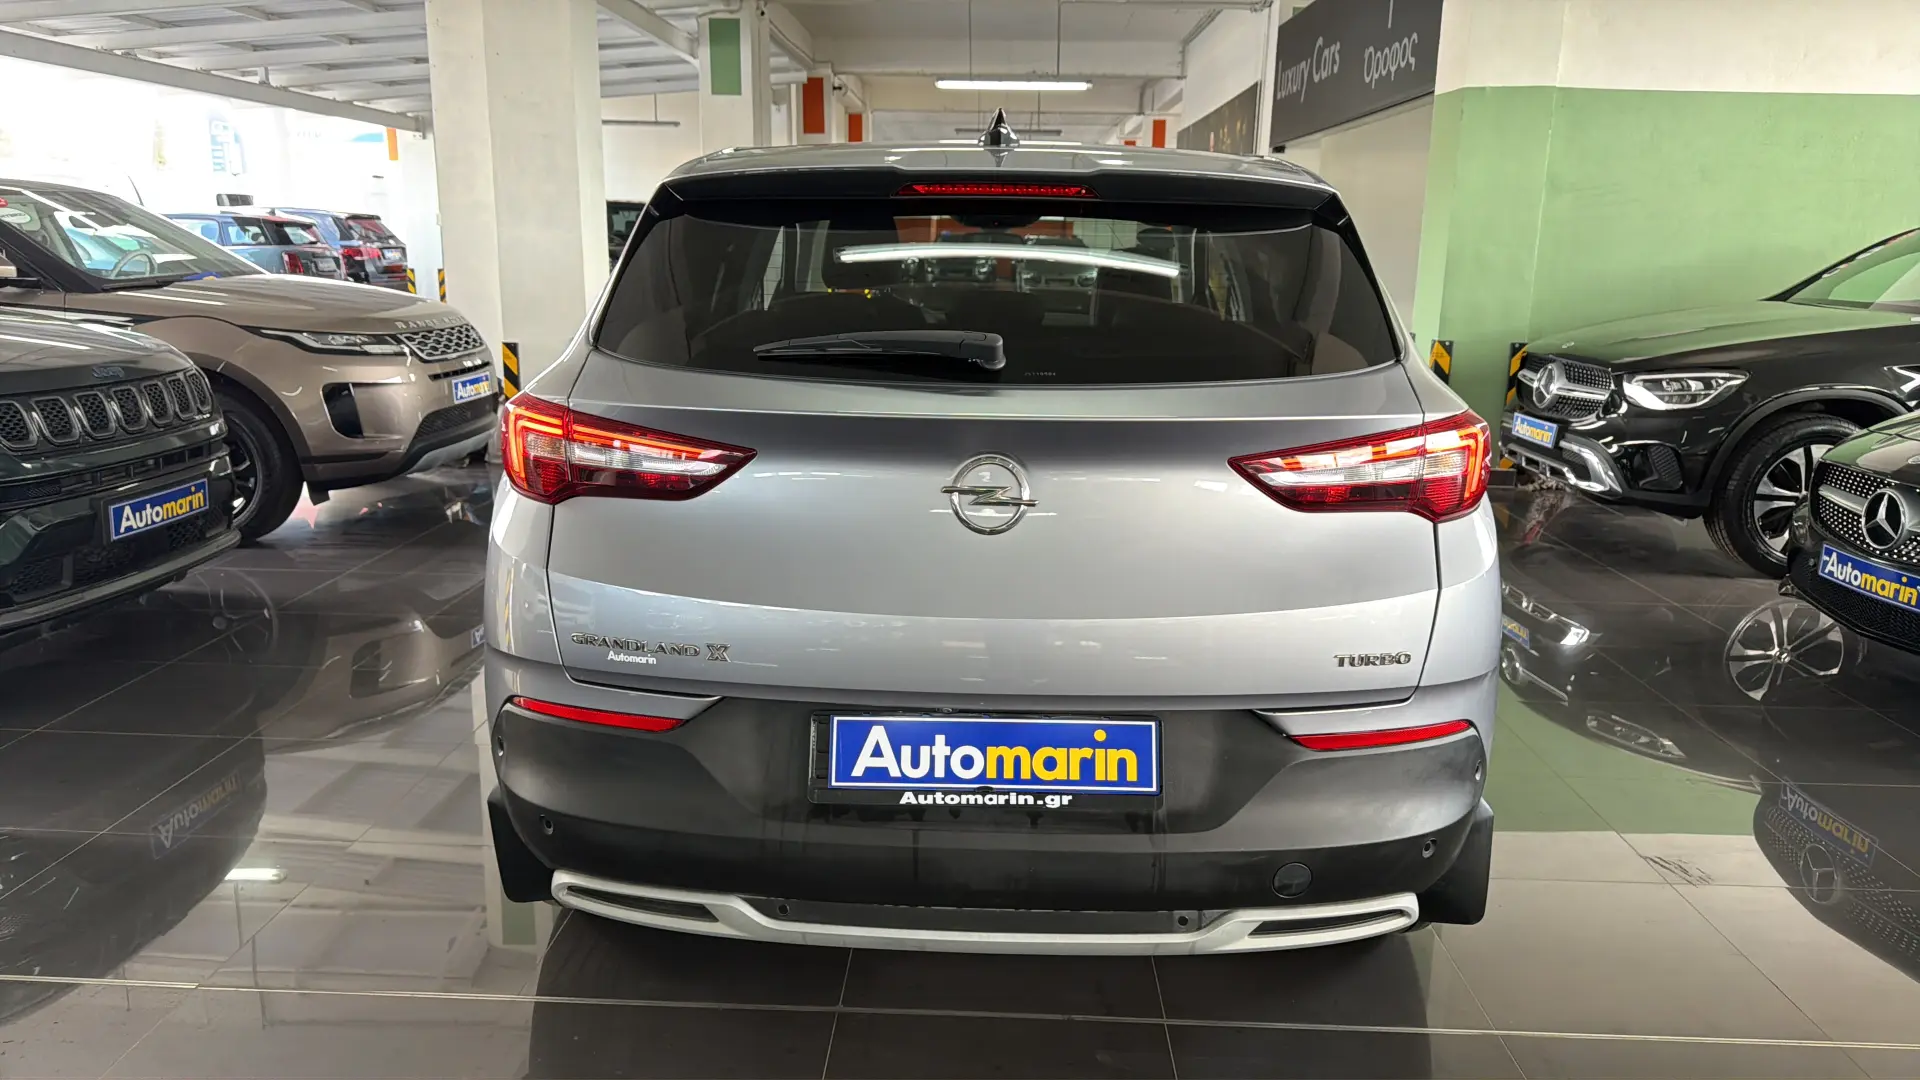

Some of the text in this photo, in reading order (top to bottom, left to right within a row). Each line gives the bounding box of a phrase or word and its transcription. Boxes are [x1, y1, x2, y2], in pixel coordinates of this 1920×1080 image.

[1277, 36, 1341, 103] Luxury Cars
[119, 486, 205, 534] Automarin
[1824, 551, 1919, 606] Automarin
[571, 632, 732, 663] GRANDLAND X
[607, 650, 657, 665] Automarin
[1332, 651, 1412, 668] TURBO
[850, 725, 1138, 782] Automarin
[899, 791, 1073, 809] Automarin.gr
